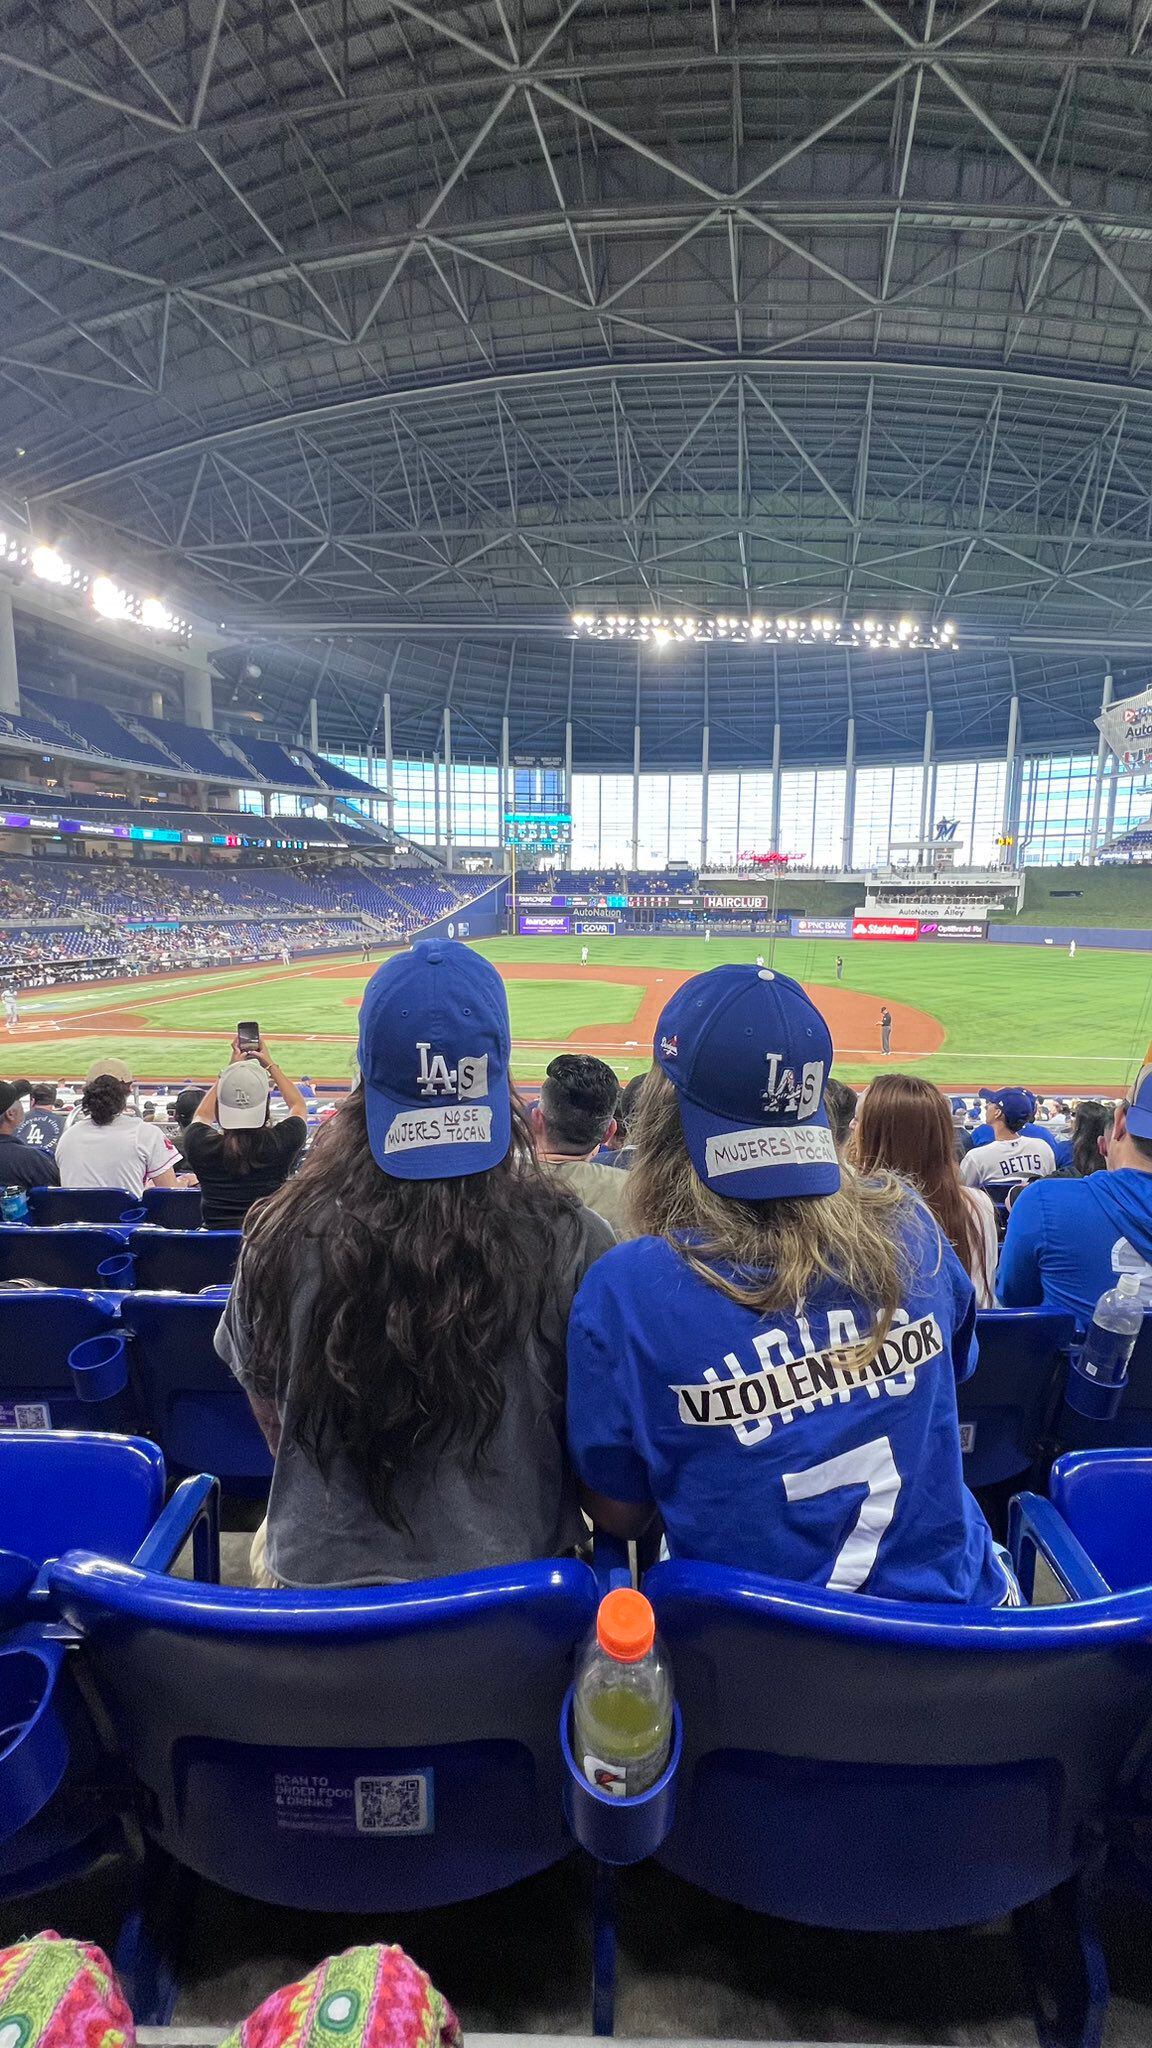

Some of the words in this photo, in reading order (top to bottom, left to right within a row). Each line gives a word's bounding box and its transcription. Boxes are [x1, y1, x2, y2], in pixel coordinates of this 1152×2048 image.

[708, 897, 762, 907] HAIRCLUB
[573, 908, 621, 918] AutoNation
[899, 908, 939, 916] AutoNation
[944, 908, 965, 918] Alley
[525, 917, 564, 926] loanDepot
[583, 924, 608, 932] GOYA
[807, 922, 825, 930] PNC
[825, 922, 846, 930] BANK
[867, 923, 892, 935] State
[891, 924, 916, 936] Farm
[236, 1088, 250, 1105] LA
[26, 1123, 45, 1144] LA
[388, 1120, 441, 1146] MUJERES
[444, 1111, 461, 1125] NO
[463, 1109, 478, 1121] SE
[447, 1126, 486, 1141] TOCAN
[714, 1138, 792, 1164] MUJERES
[794, 1130, 815, 1143] NO
[999, 1154, 1041, 1177] BETTS
[681, 1319, 941, 1423] VIOLENTADOR
[782, 1436, 902, 1592] 7
[276, 1775, 309, 1787] SCAN
[311, 1776, 329, 1787] TO
[276, 1785, 316, 1797] ORDER
[319, 1788, 354, 1799] FOOD
